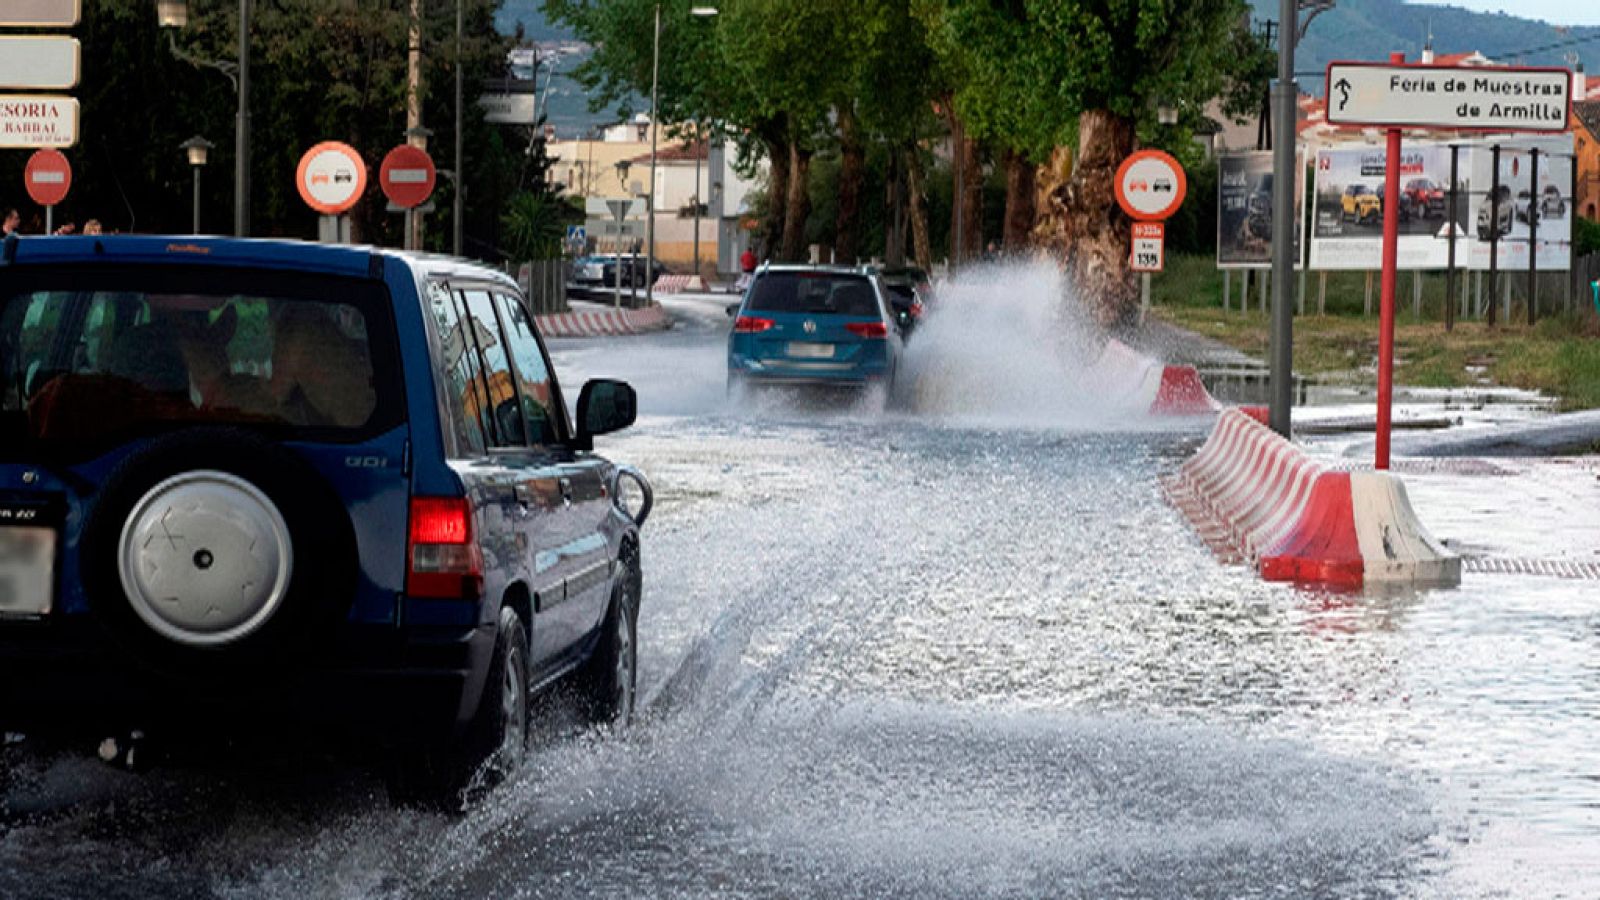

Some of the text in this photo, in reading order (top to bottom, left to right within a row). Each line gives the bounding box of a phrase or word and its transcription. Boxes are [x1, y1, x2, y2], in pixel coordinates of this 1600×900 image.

[1390, 75, 1562, 95] Feria de Muestras
[1456, 102, 1562, 120] de Armilla
